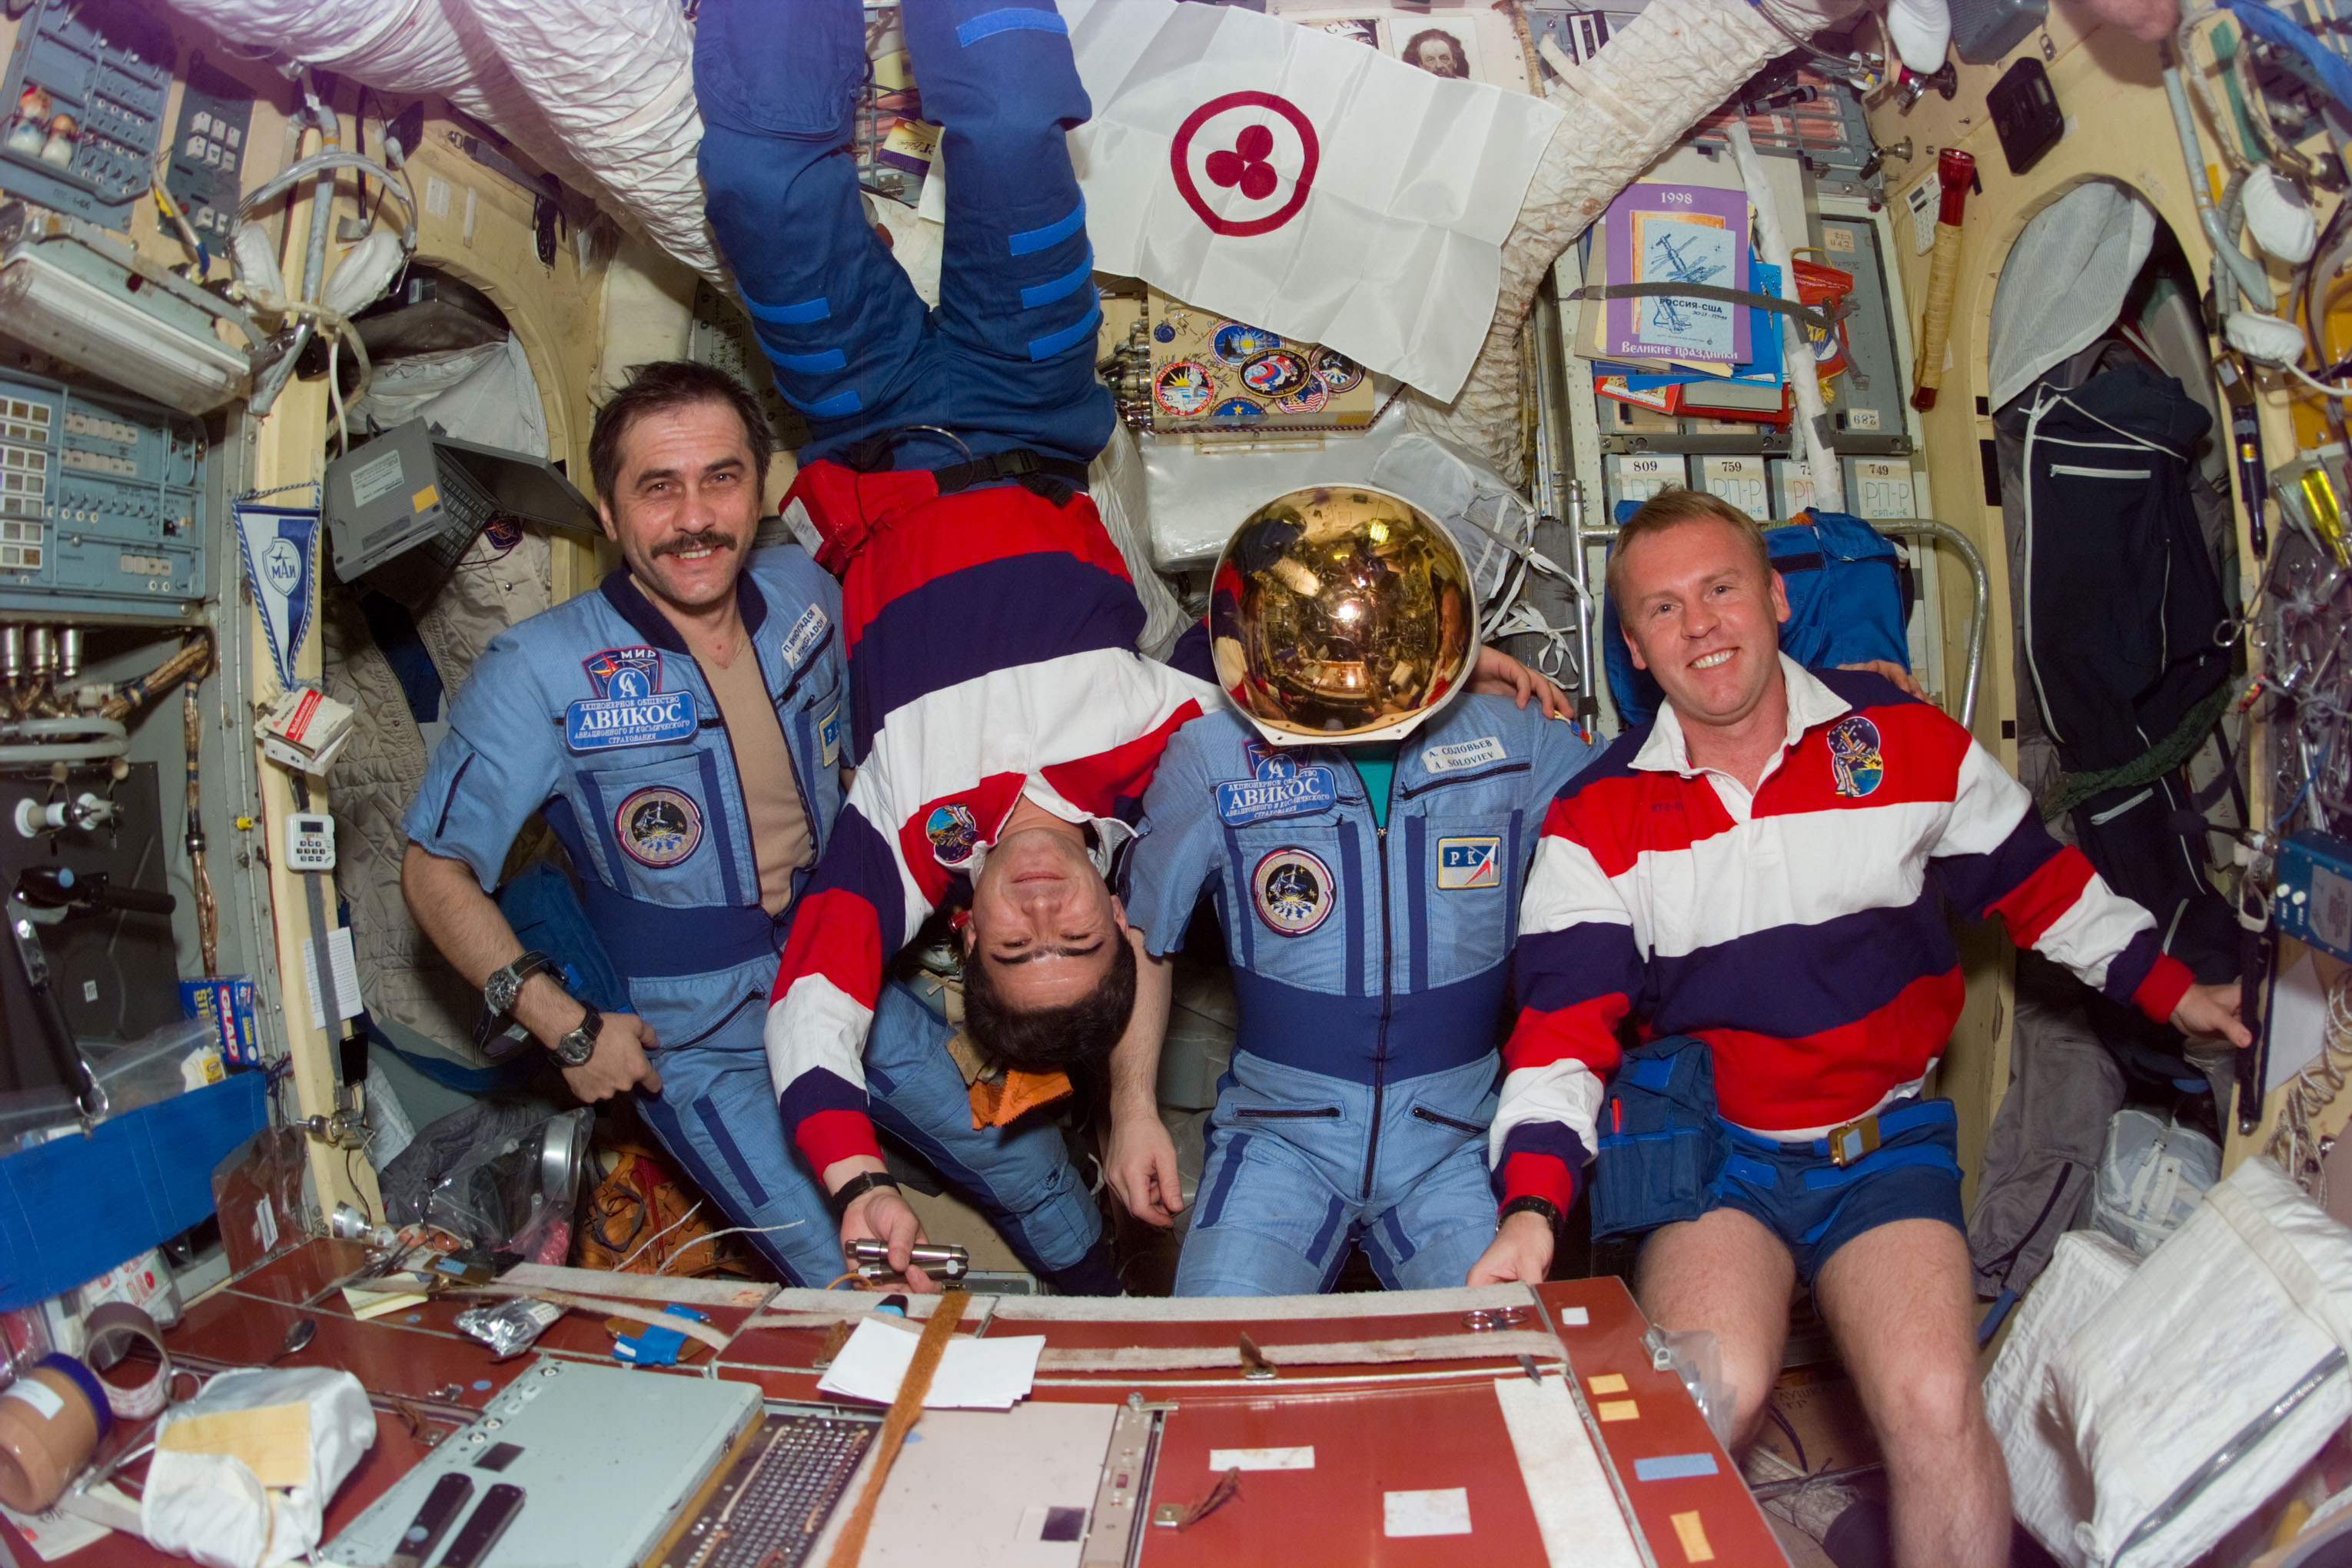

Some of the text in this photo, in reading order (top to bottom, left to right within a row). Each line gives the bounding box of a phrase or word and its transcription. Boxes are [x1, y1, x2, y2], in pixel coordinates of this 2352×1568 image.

[1661, 192, 1693, 204] 1998
[1659, 298, 1722, 314] РОССИЯ-США
[1633, 460, 1657, 472] 809
[1721, 461, 1742, 472] 759
[1869, 463, 1889, 476] 749
[1865, 481, 1909, 507] РП-Р
[271, 558, 297, 579] МАИ
[620, 649, 657, 659] МИР
[580, 696, 680, 712] АКЦИОНЕРНОЕ ОБЩЕСТВО
[580, 703, 682, 731] АВИКОС
[608, 733, 657, 745] СТРАХОВАНИЯ
[1447, 751, 1494, 768] SOLOVIEV
[1230, 777, 1321, 809] АВИКОС
[221, 988, 238, 1057] GLAD
